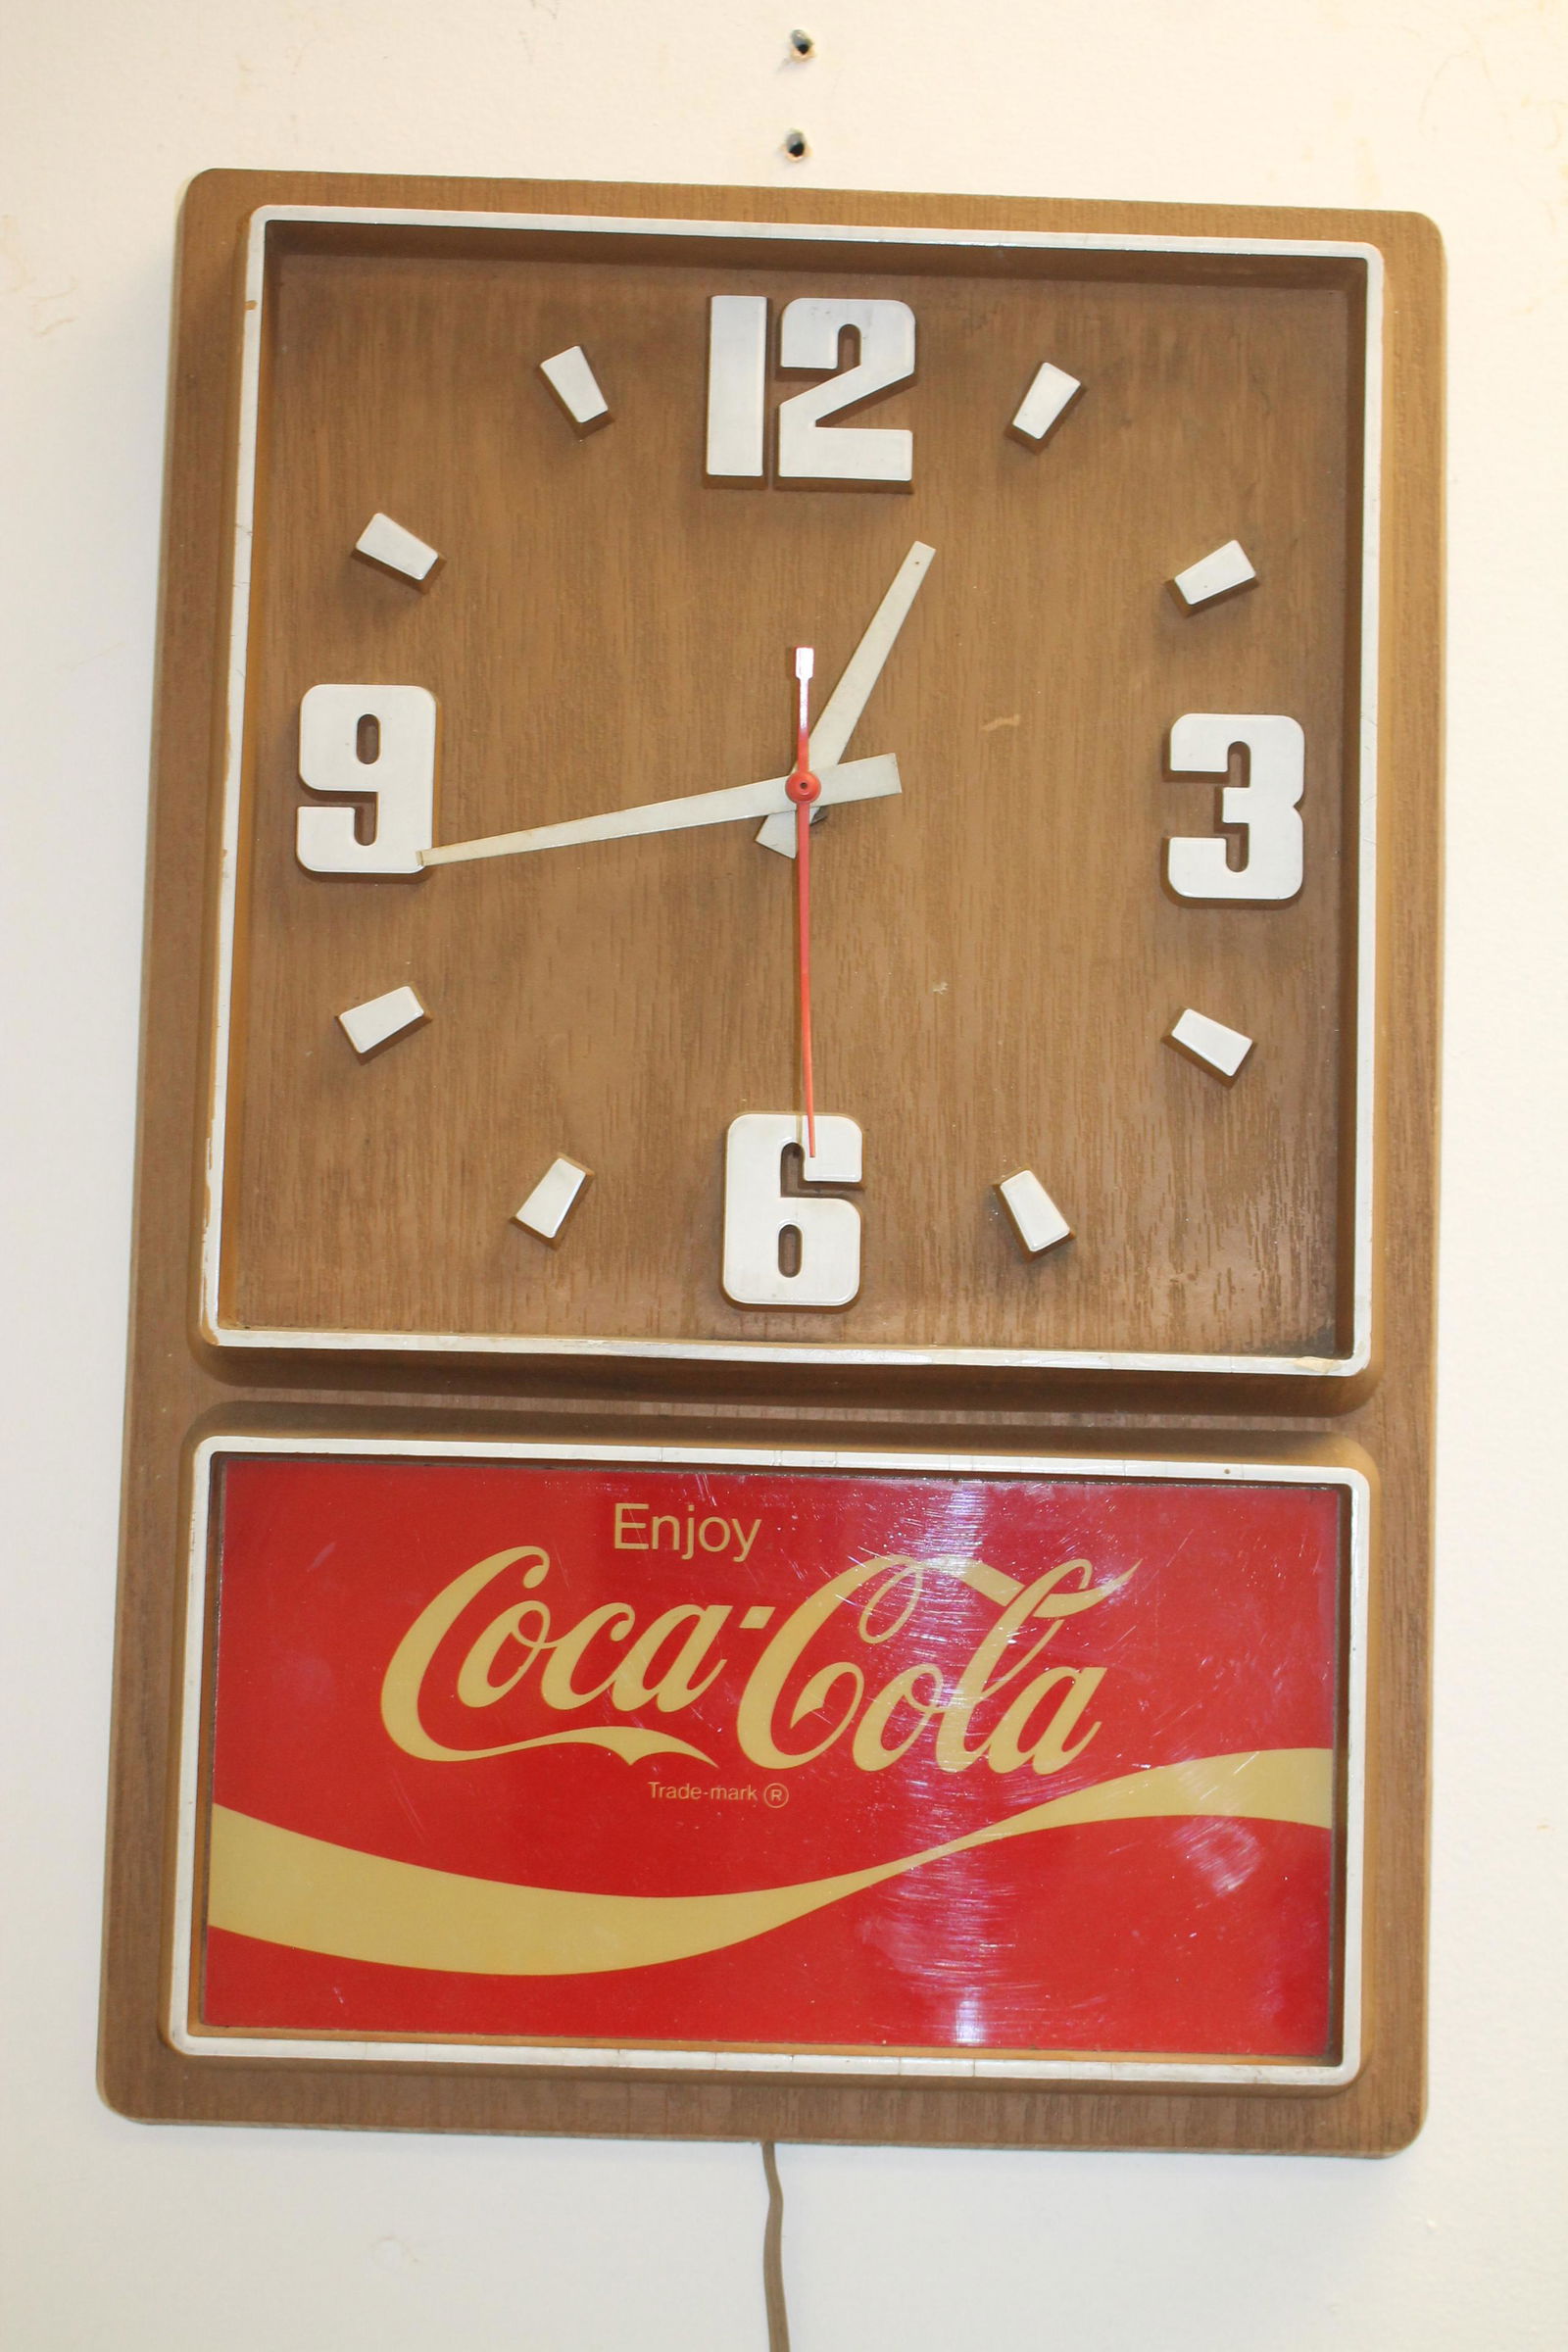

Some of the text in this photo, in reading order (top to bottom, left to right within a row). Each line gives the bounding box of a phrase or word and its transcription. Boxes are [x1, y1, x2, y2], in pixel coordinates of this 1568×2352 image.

[707, 295, 916, 481] 12
[297, 684, 437, 874] 9
[1168, 713, 1304, 900] 3
[722, 1113, 862, 1306] 6
[612, 1502, 761, 1562] Enjoy
[380, 1544, 1143, 1775] Coca-Cola
[648, 1781, 759, 1801] Trade-mark
